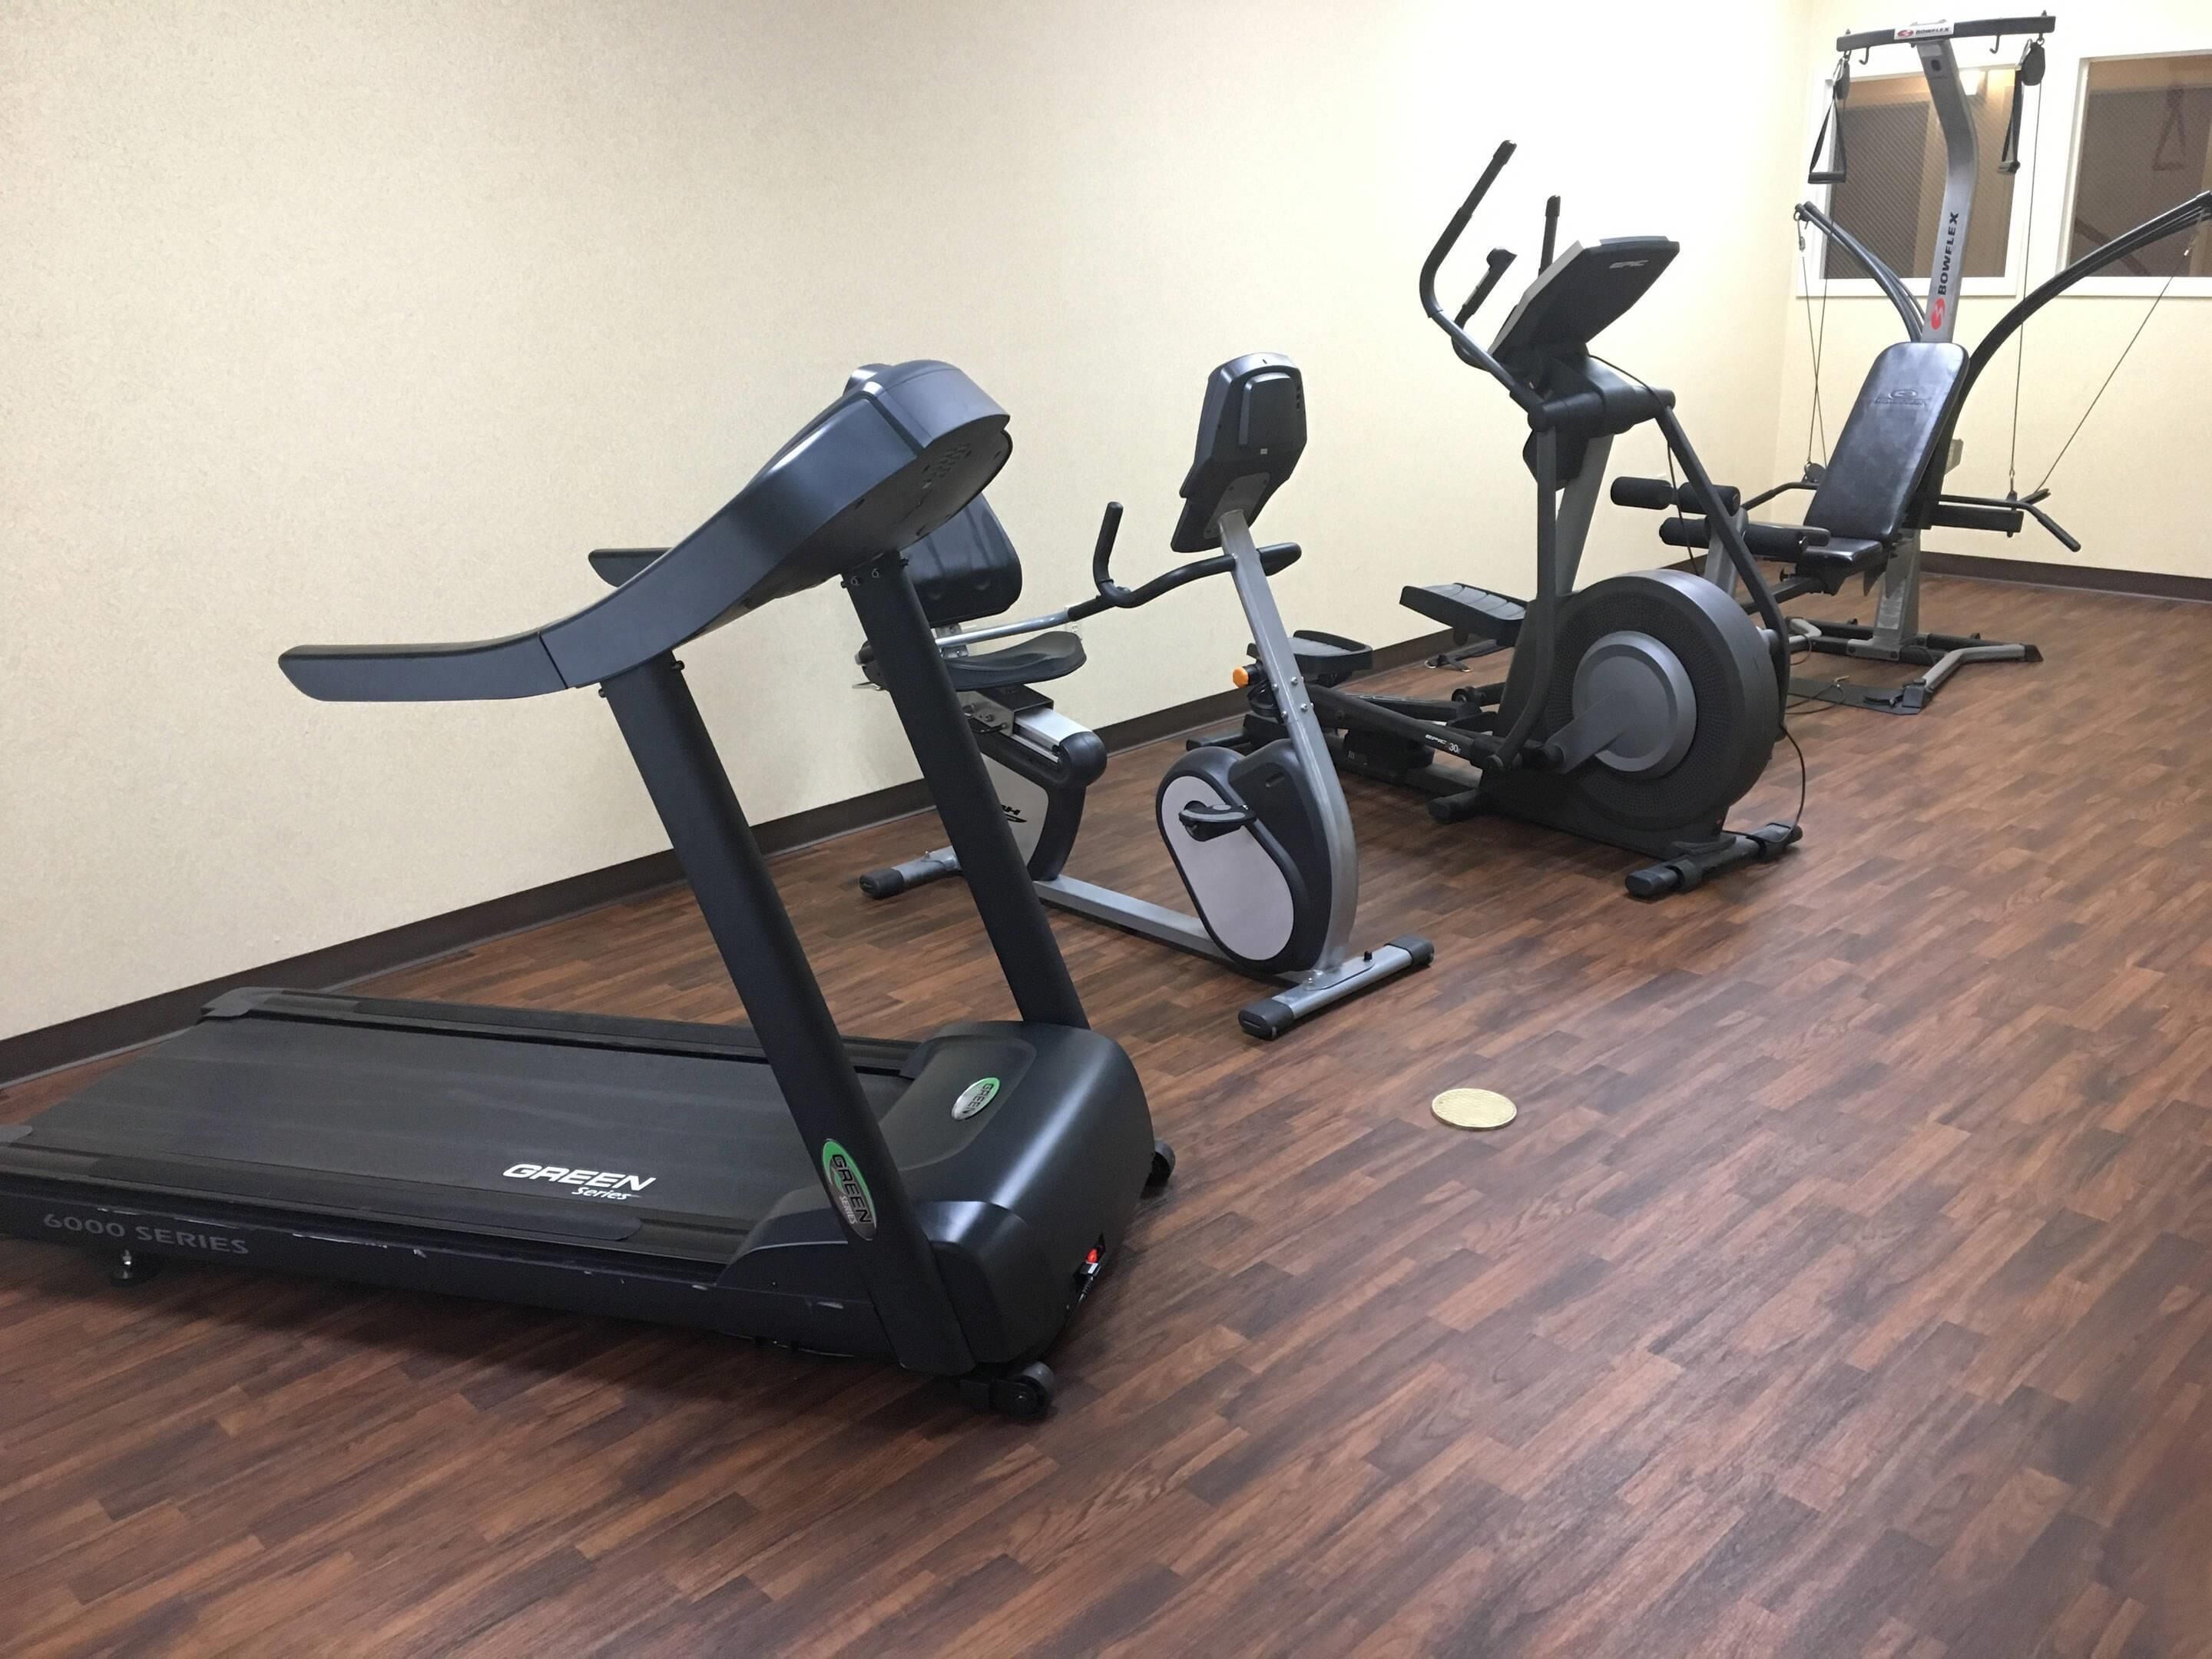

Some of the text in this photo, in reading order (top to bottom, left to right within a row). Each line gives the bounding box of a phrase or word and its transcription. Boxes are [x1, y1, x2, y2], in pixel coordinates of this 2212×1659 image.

[1937, 211, 1959, 296] BOWFLEX
[962, 1083, 994, 1114] GREEN
[502, 1164, 657, 1191] GREEN
[571, 1186, 636, 1200] Series
[832, 1154, 872, 1223] GREEN
[839, 1195, 858, 1224] SERIES
[43, 1214, 249, 1254] 6000 SERIES
